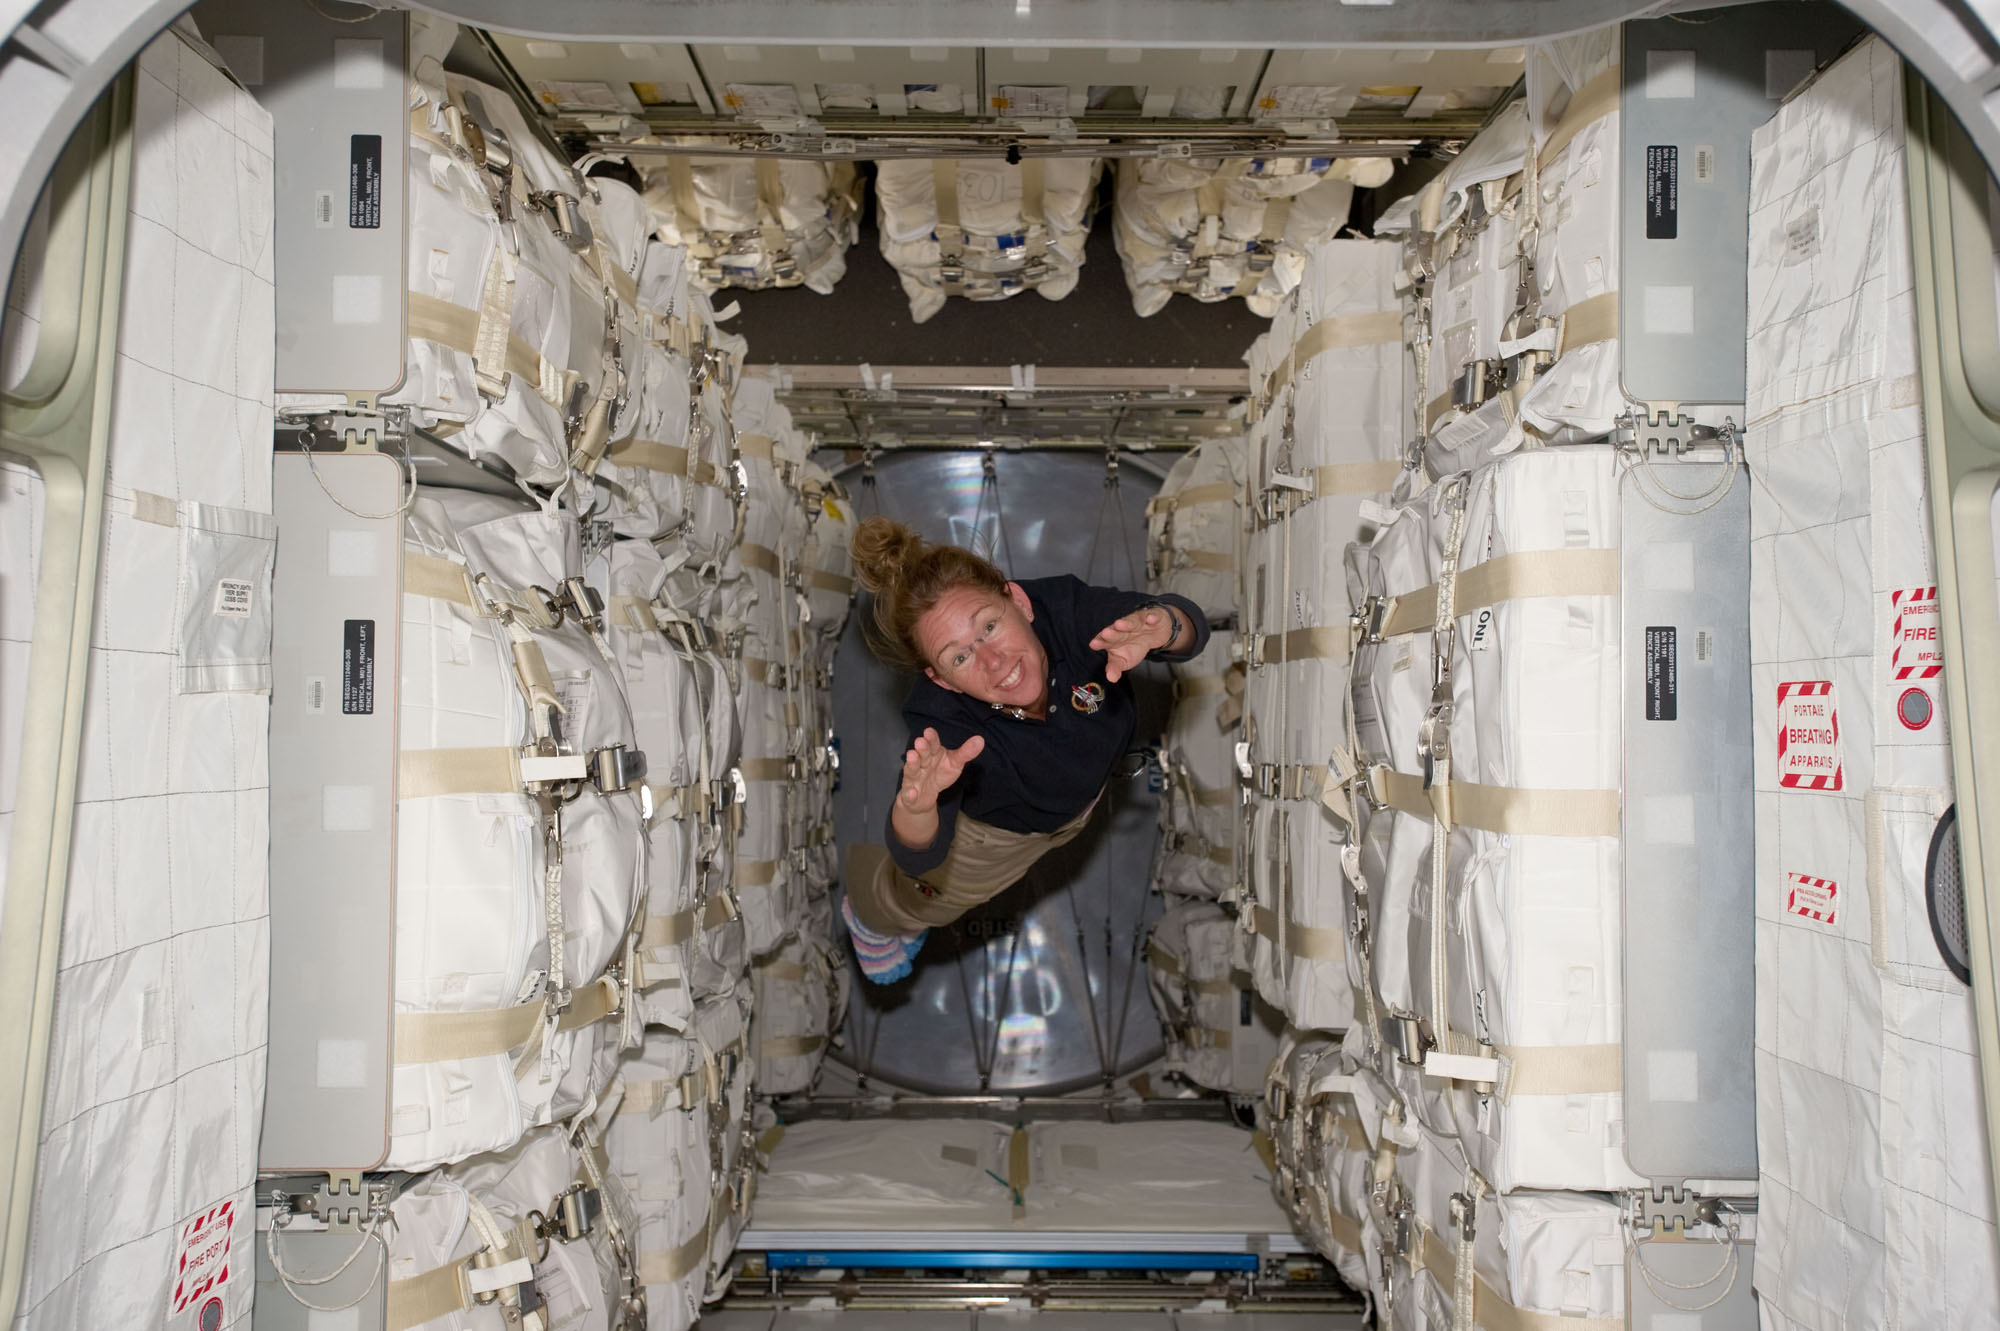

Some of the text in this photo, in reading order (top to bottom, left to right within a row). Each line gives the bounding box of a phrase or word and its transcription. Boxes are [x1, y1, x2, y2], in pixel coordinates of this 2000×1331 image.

[1904, 627, 1936, 641] FIRE
[215, 1218, 227, 1230] USE
[189, 1240, 224, 1273] FIRE PORT
